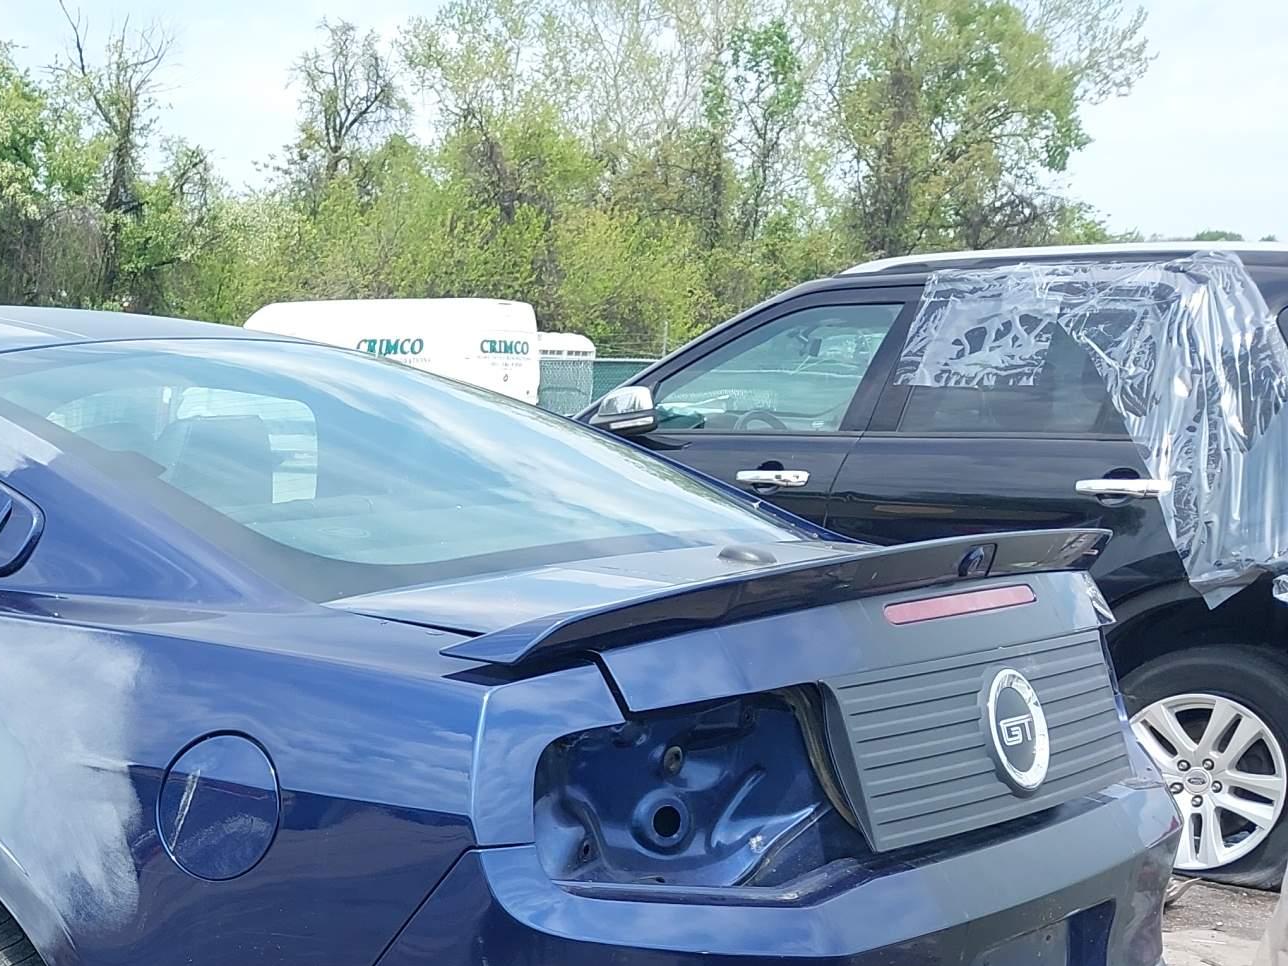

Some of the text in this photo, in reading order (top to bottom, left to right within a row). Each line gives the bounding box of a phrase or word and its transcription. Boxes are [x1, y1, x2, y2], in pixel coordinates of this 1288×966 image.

[356, 338, 424, 356] CRIMCO
[480, 339, 529, 355] CRIMCO
[999, 713, 1033, 746] GT
